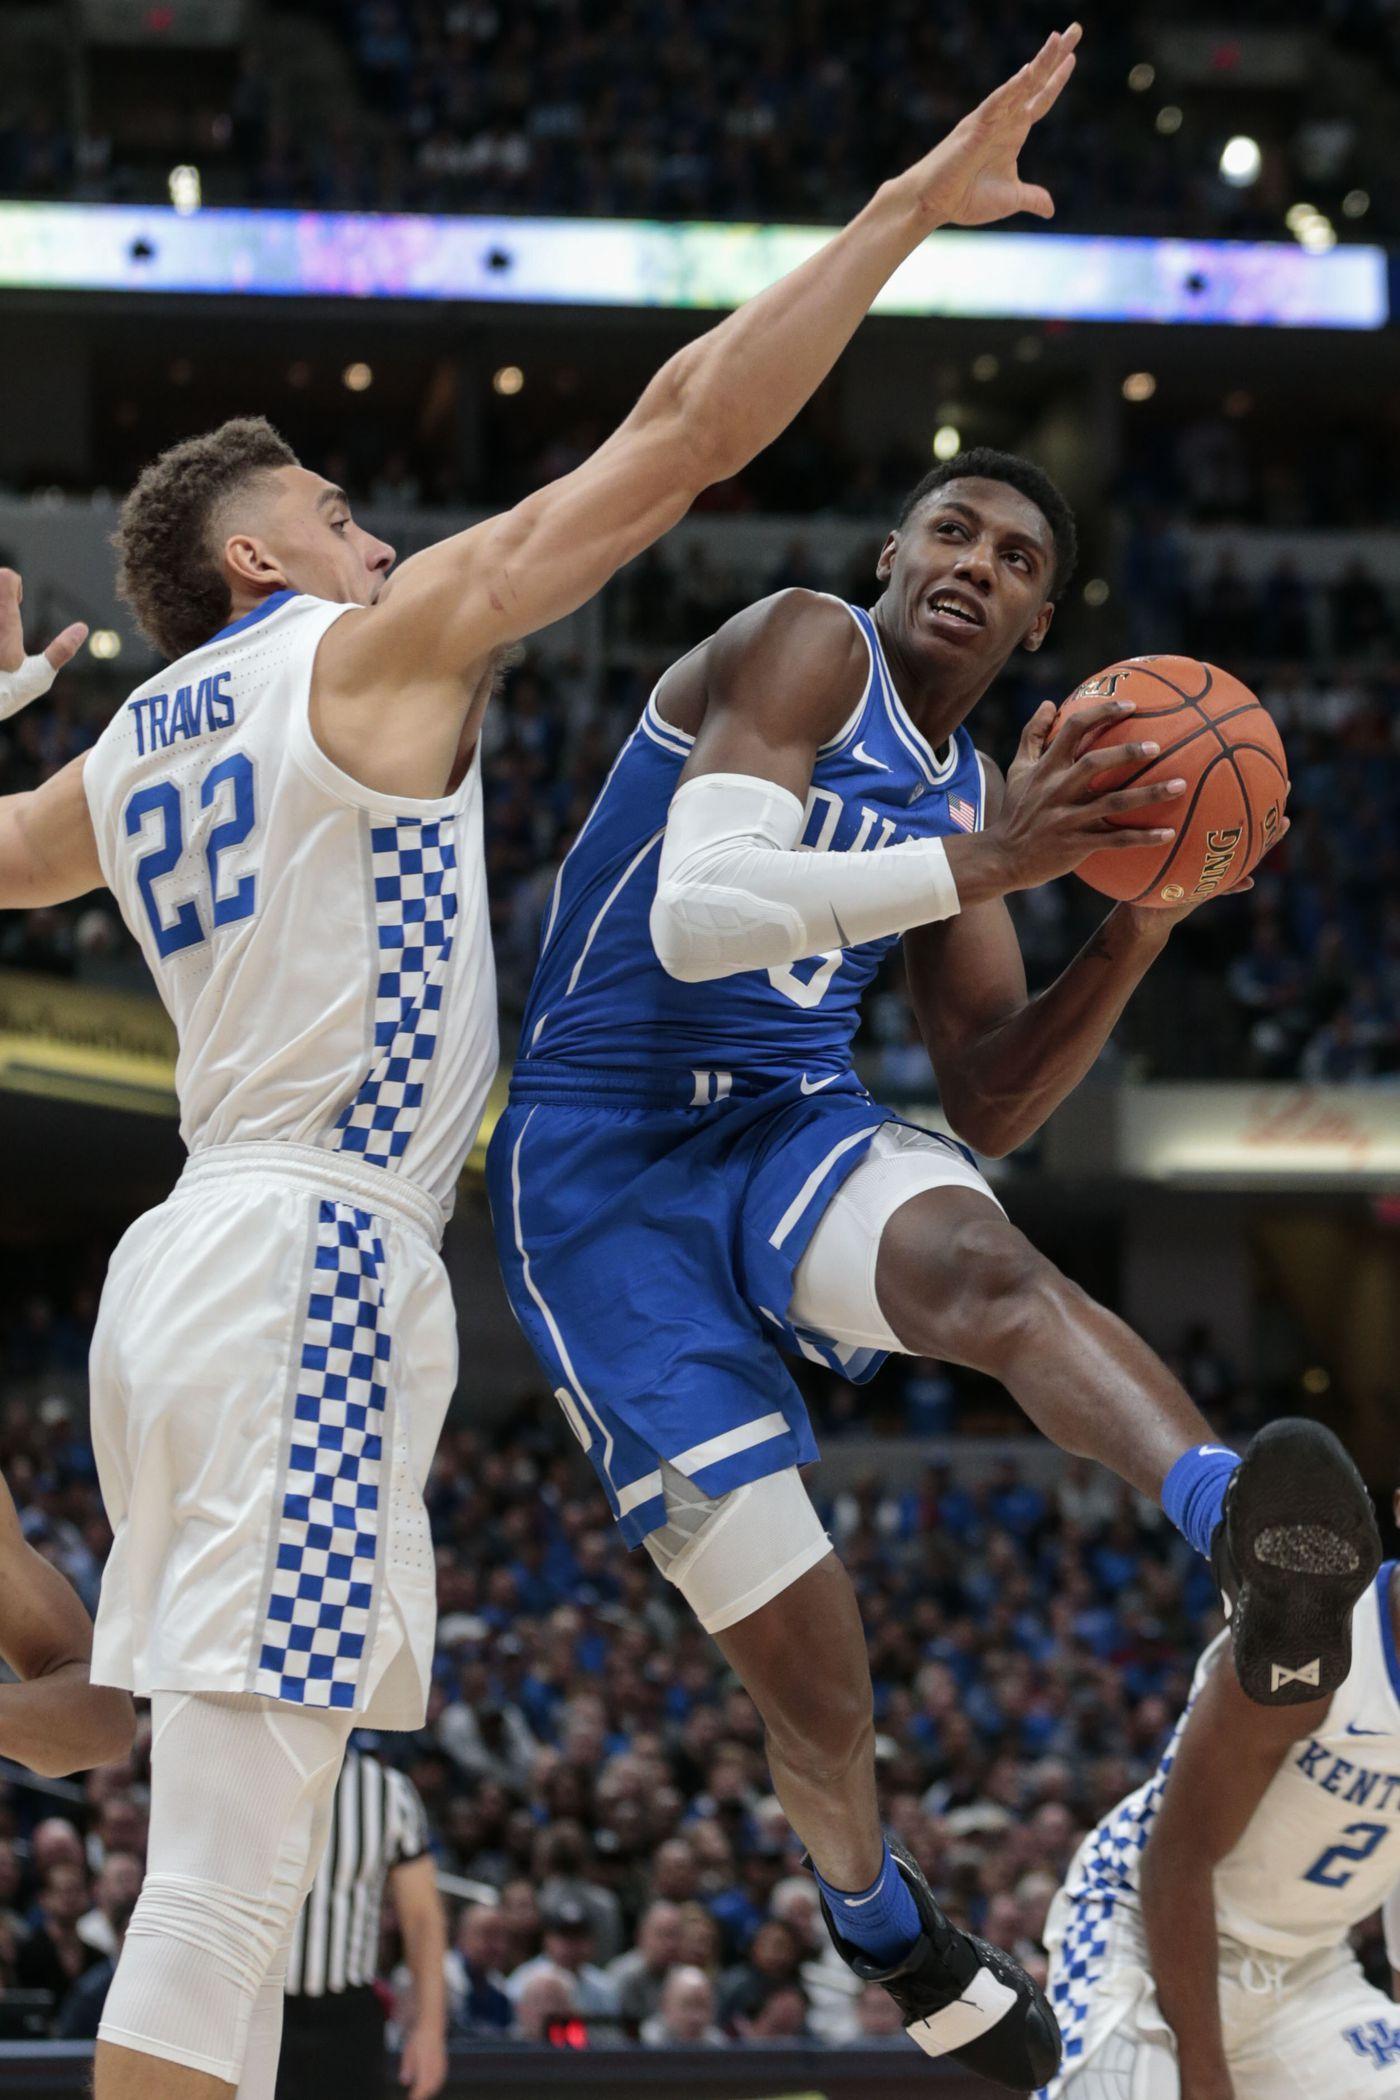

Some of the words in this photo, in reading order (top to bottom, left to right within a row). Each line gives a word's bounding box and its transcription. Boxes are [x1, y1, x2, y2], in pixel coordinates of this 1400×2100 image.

[127, 670, 236, 757] TRAVIS
[124, 751, 257, 960] 22
[1296, 1738, 1400, 1811] KENT
[1302, 1821, 1390, 1889] 2
